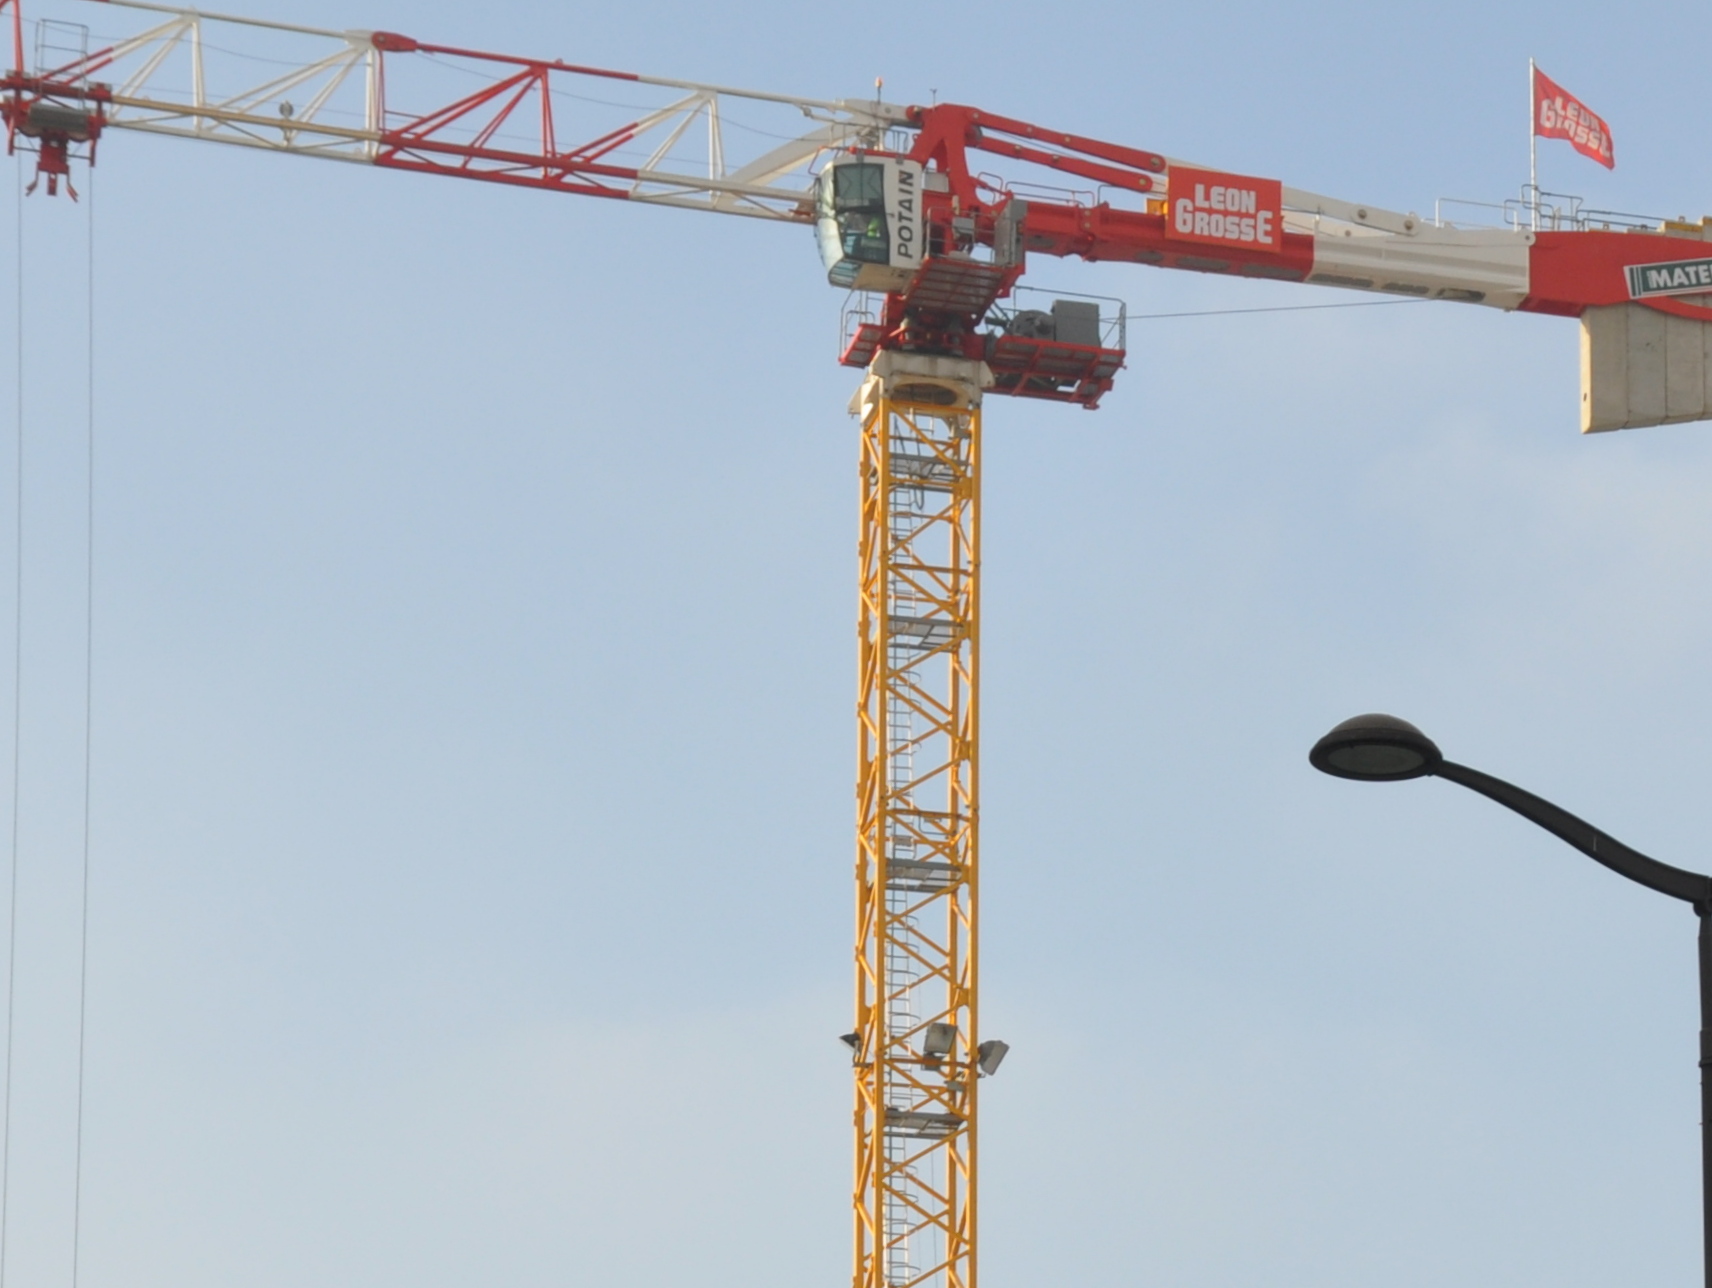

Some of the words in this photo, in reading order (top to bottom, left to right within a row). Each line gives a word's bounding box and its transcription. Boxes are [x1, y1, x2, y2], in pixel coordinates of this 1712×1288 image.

[898, 170, 914, 259] POTAIN
[1175, 198, 1273, 244] GROSSE
[1195, 183, 1256, 214] LEON
